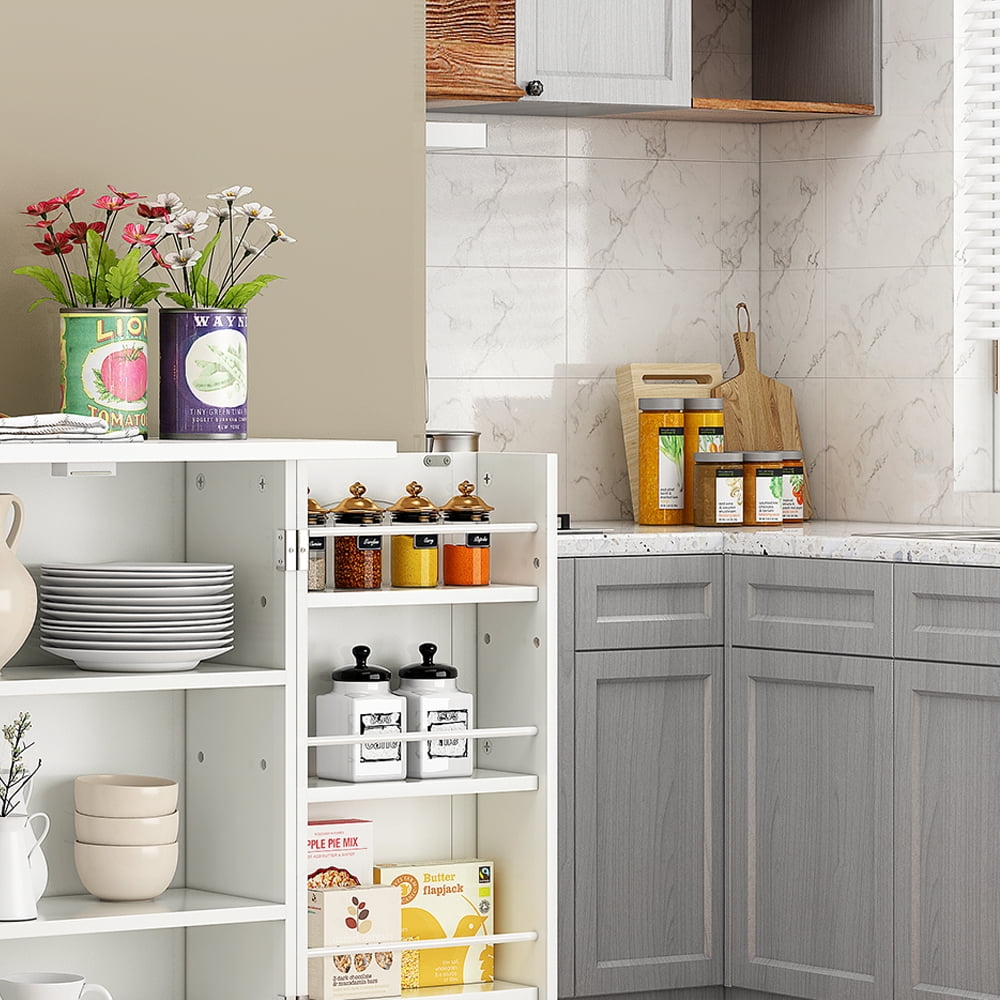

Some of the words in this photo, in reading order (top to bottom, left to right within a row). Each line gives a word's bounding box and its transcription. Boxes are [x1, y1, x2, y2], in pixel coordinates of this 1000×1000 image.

[328, 838, 341, 848] PIE
[343, 837, 358, 847] MIX
[423, 873, 456, 883] Butter
[423, 884, 464, 897] flapjack
